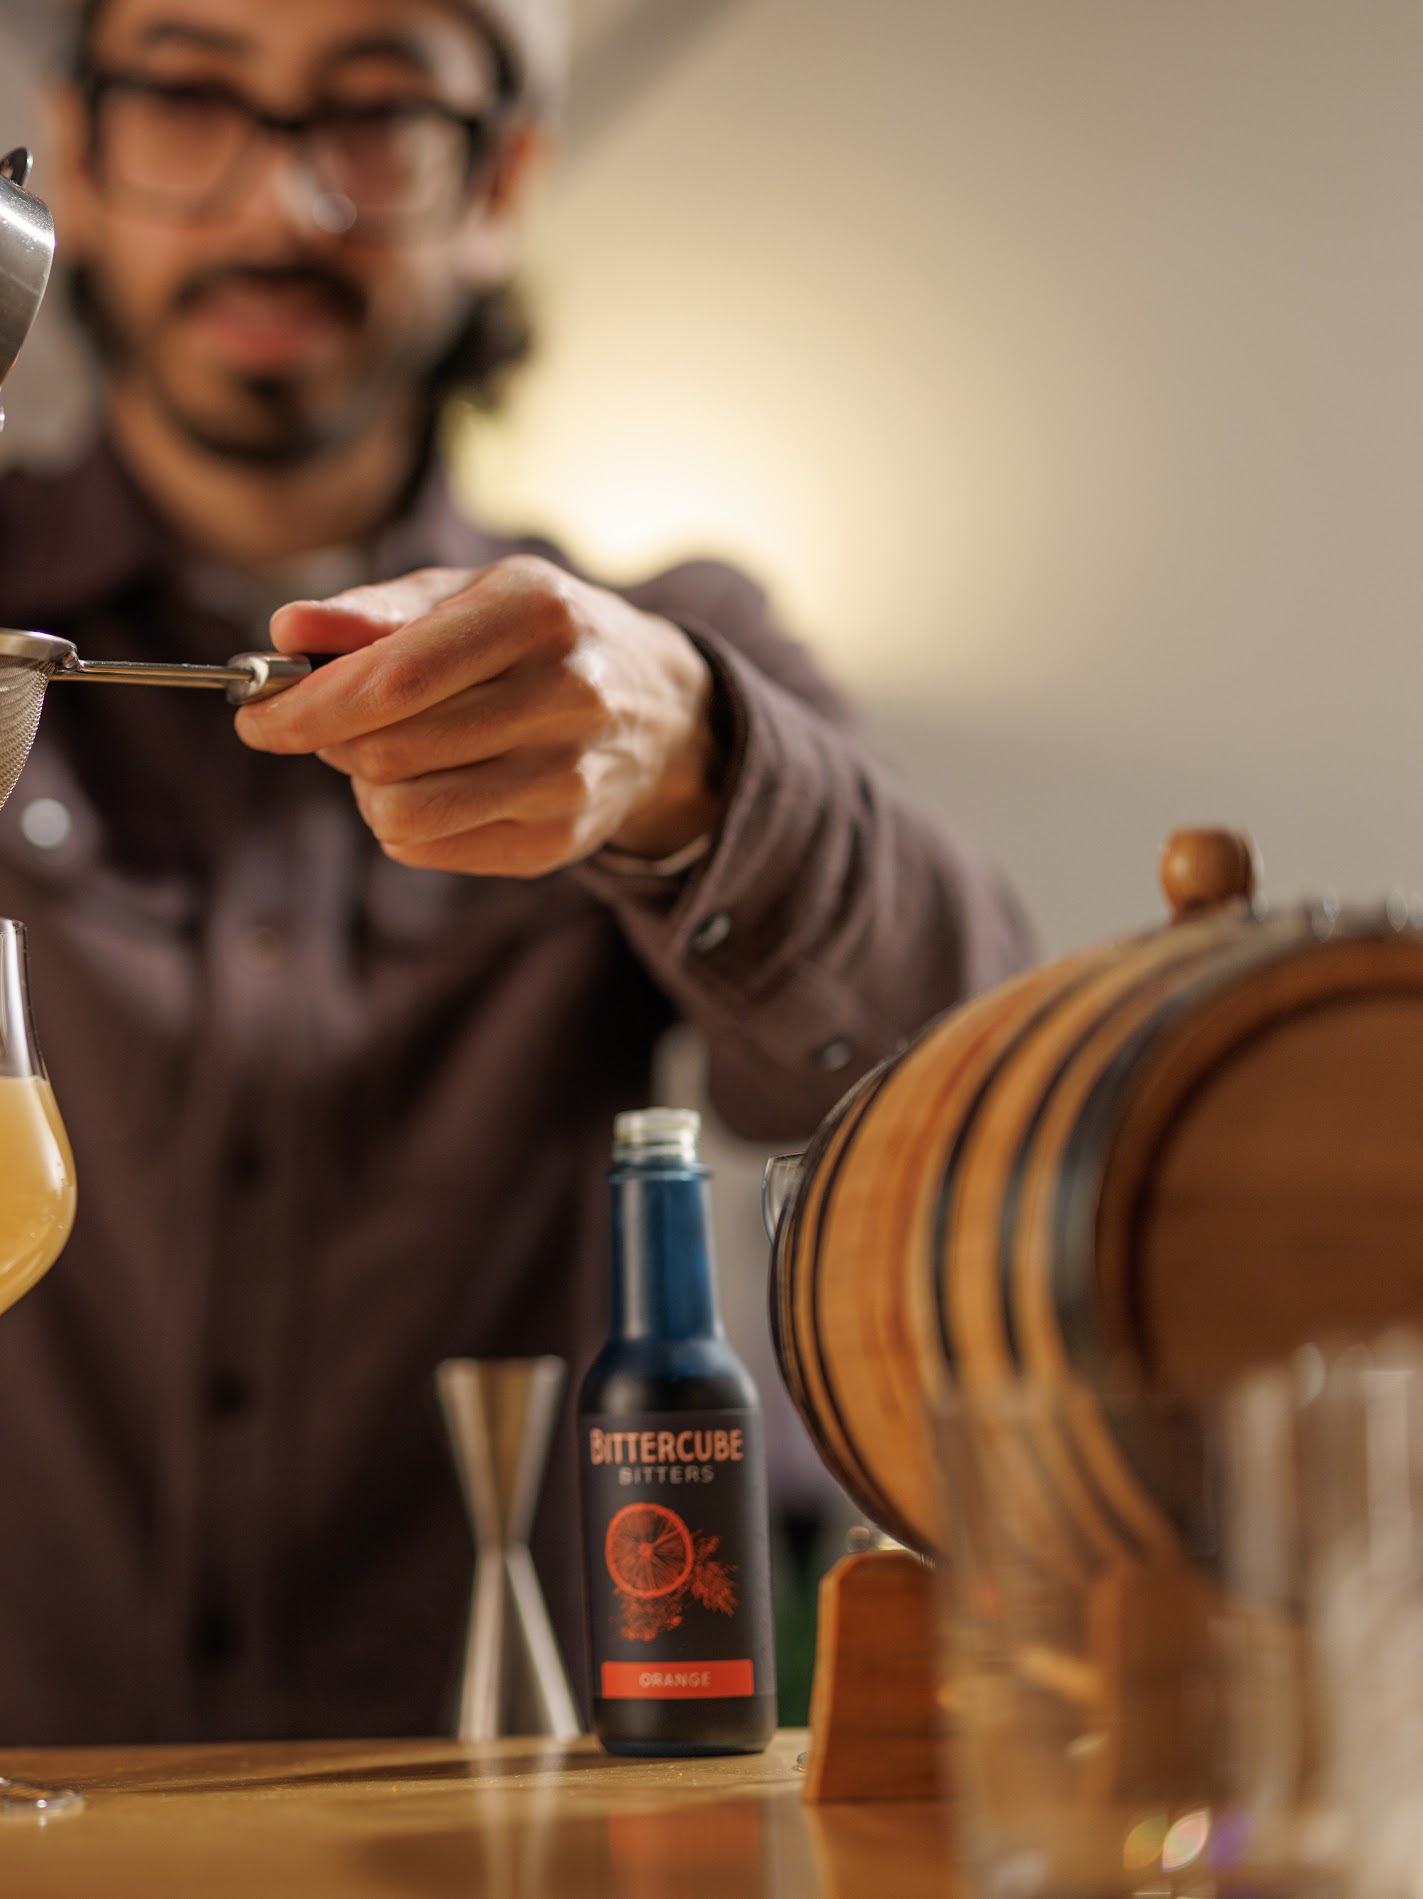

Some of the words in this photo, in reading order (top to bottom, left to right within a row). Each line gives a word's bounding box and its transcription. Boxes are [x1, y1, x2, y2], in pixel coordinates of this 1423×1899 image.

[589, 1427, 744, 1465] BITTERCUBE
[618, 1465, 714, 1486] BITTERS
[638, 1670, 712, 1688] ORANGE
